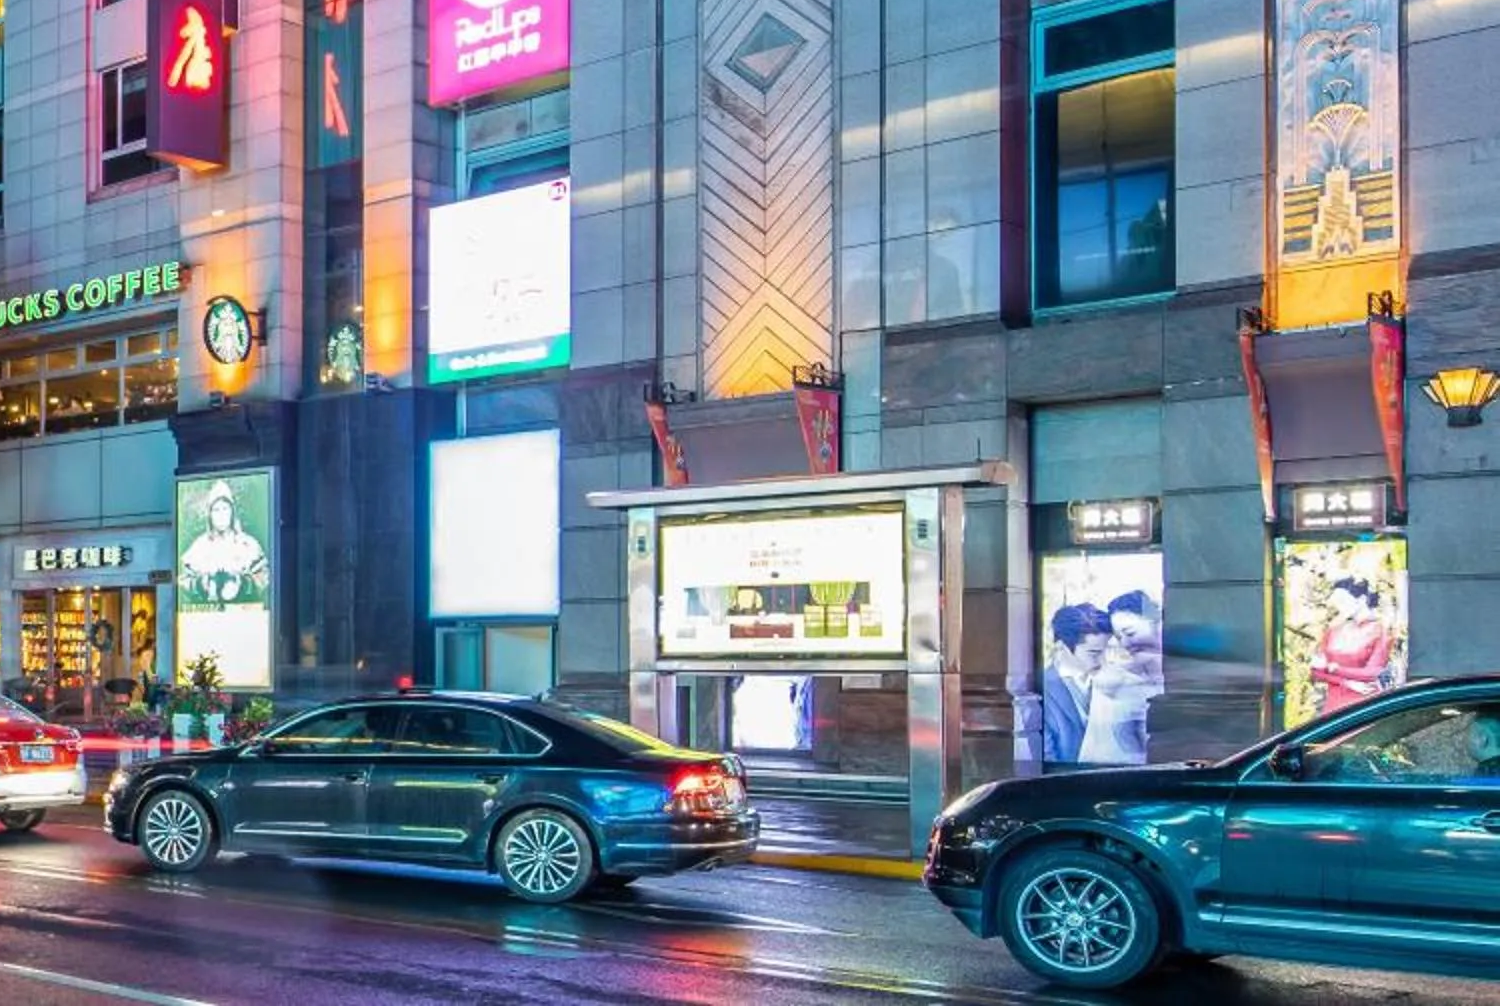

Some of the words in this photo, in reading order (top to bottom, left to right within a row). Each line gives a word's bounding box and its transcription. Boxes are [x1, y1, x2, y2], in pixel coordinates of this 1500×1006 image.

[65, 262, 181, 311] COFFEE
[23, 545, 122, 571] 星巴克咖啡
